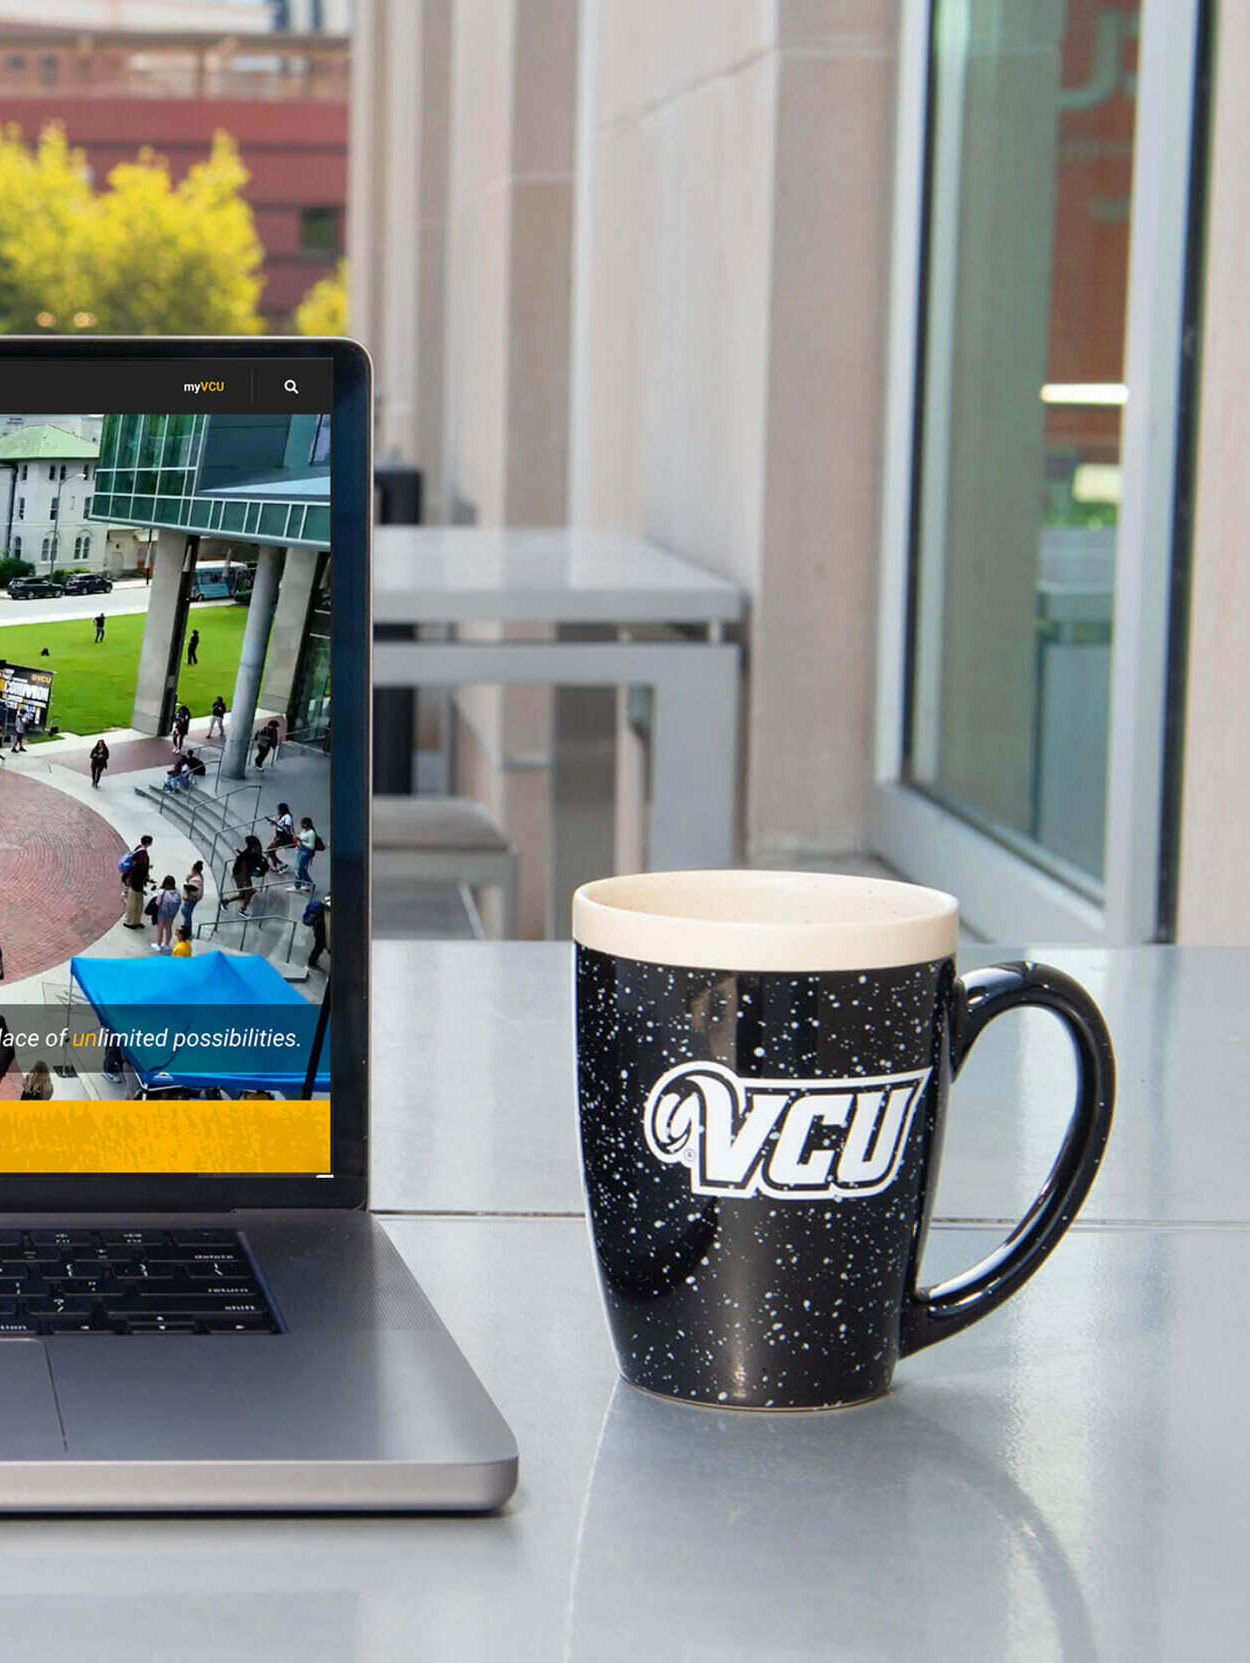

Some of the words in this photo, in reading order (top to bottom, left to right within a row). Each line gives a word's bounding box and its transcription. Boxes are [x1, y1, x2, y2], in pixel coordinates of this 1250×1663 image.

[183, 381, 225, 394] myVCU
[45, 1027, 69, 1048] of
[72, 1027, 168, 1047] unlimited
[172, 1028, 301, 1052] possibilities.
[686, 1068, 930, 1198] VCU
